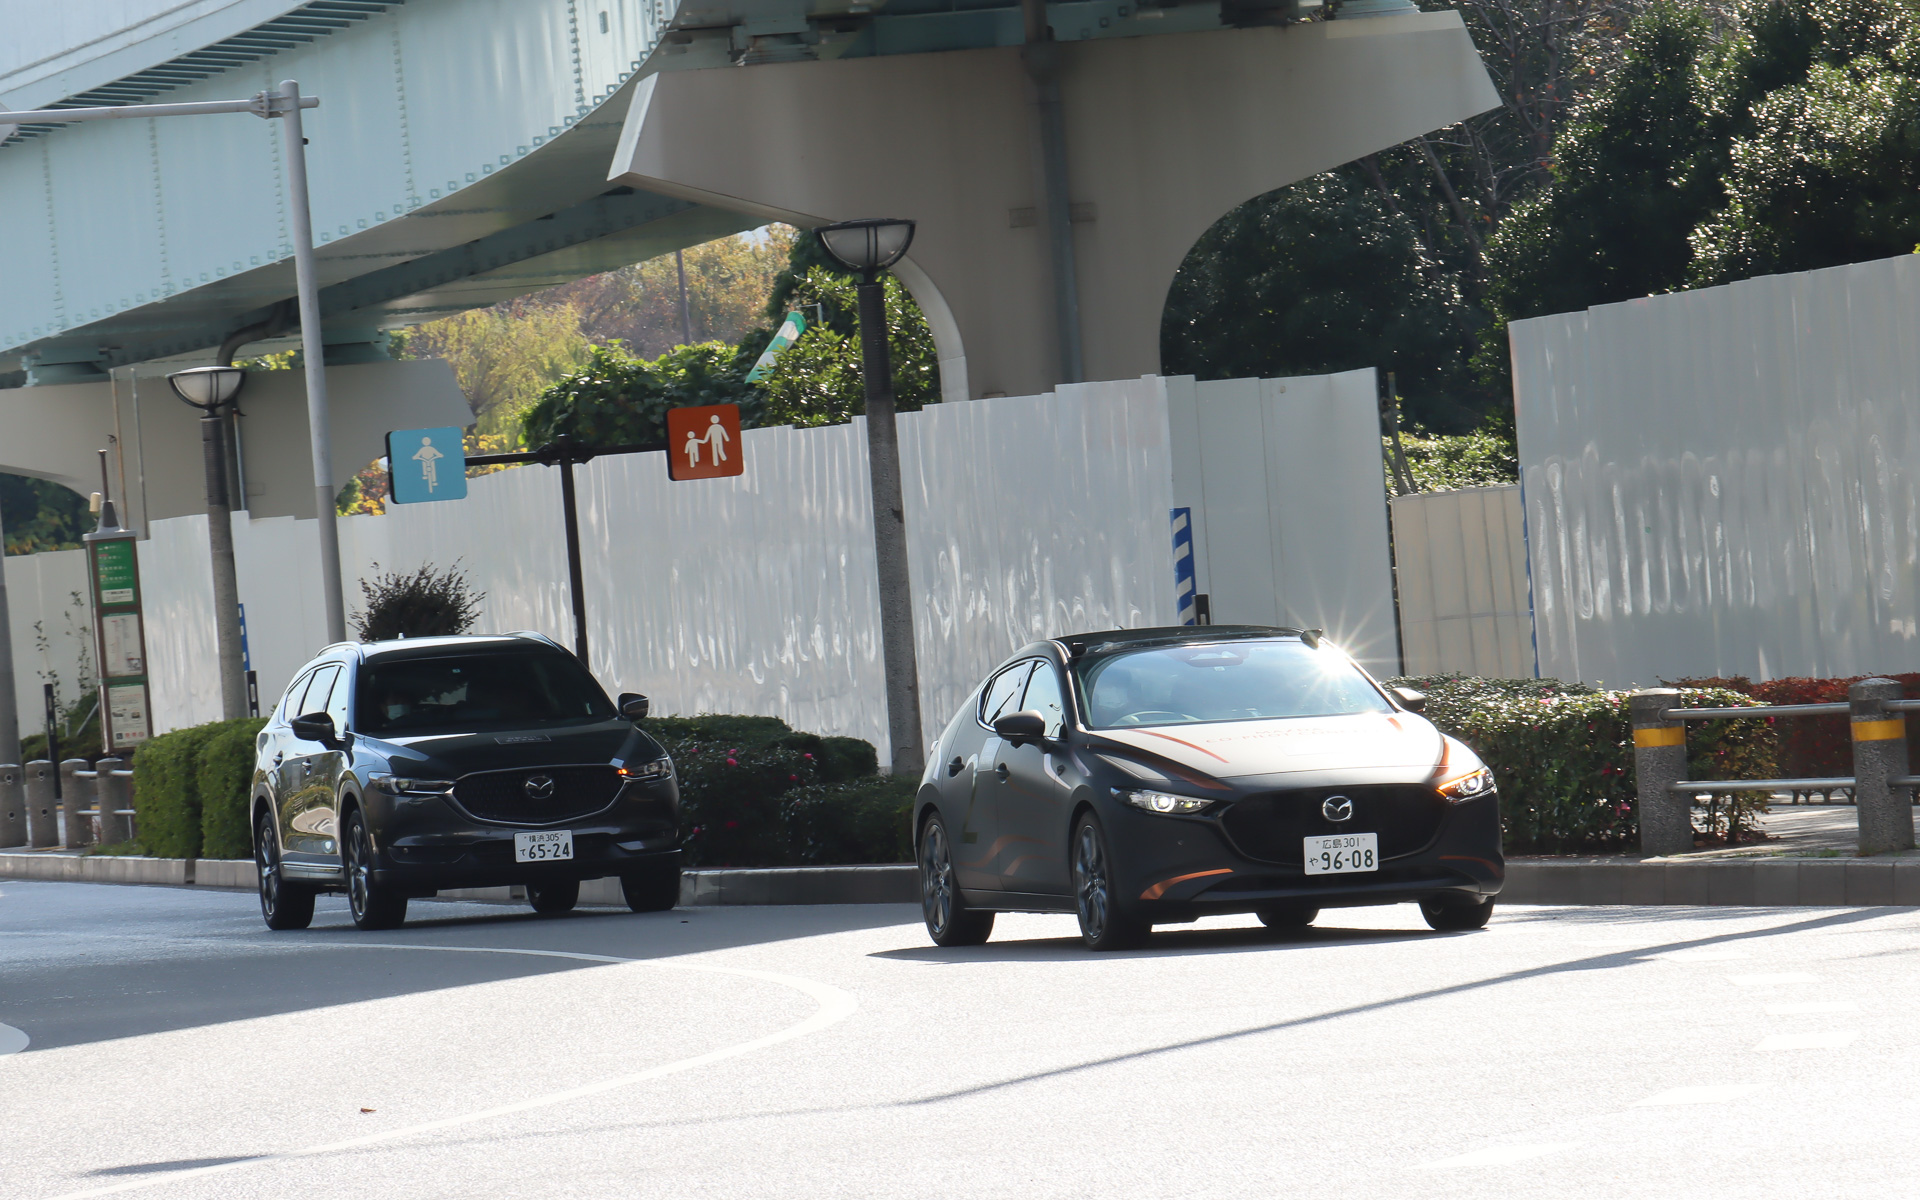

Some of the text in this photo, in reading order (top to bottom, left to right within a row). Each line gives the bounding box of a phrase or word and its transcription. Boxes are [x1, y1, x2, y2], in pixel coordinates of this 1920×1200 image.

[529, 842, 570, 859] 65-24
[1309, 849, 1374, 871] や 96-08
